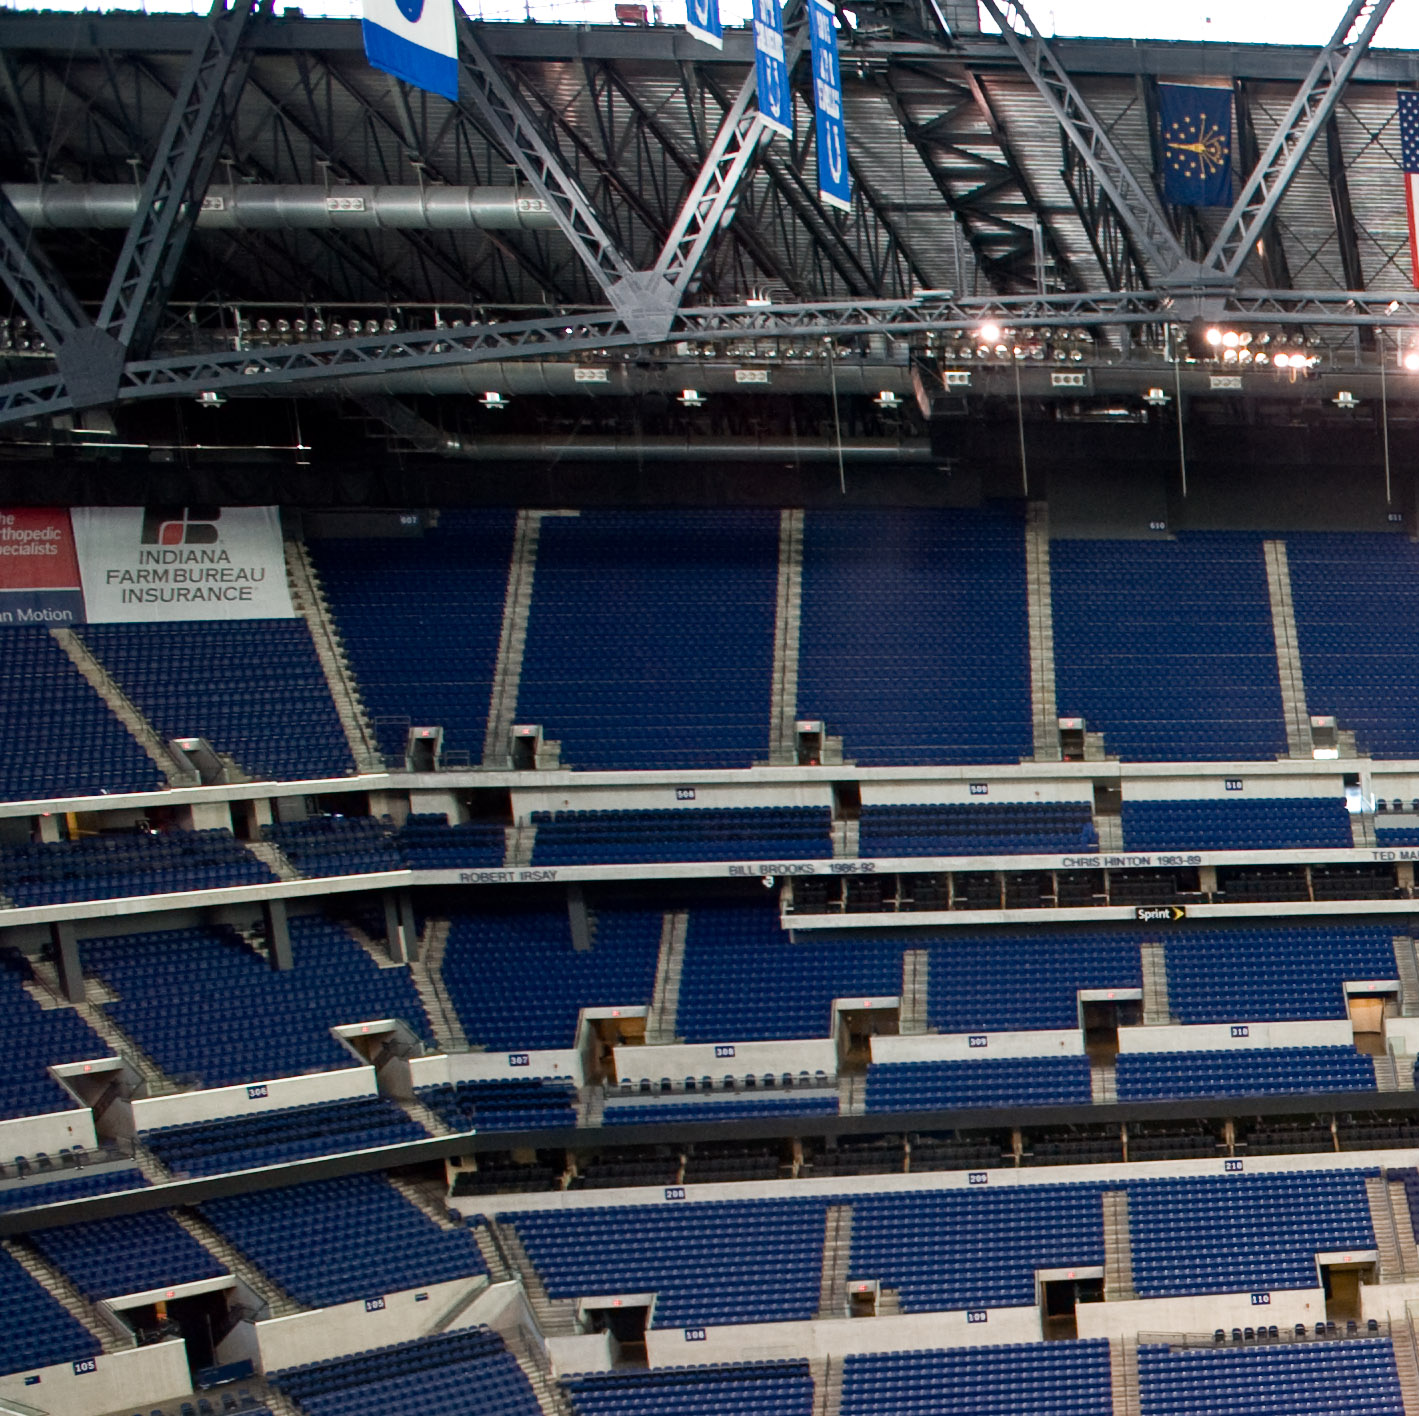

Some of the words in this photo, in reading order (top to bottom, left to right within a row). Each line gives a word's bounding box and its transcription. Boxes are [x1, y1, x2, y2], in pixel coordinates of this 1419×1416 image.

[0, 511, 14, 525] he
[400, 516, 417, 524] 607
[0, 526, 61, 543] thopedic
[139, 549, 230, 565] INDIANA
[106, 569, 172, 585] FARM
[174, 567, 265, 583] BUREAU
[122, 586, 252, 604] INSURANCE
[17, 607, 73, 622] Motion
[1226, 781, 1243, 790] 510
[1062, 856, 1100, 867] CHRIS
[1104, 855, 1151, 867] HINTON
[1372, 850, 1396, 861] TED
[729, 865, 756, 876] BILL
[760, 864, 815, 875] BROOKS
[460, 871, 514, 883] ROBERT
[520, 869, 558, 882] IRSAY
[1137, 906, 1171, 922] Sprint
[1232, 1027, 1249, 1036] 310
[970, 1037, 987, 1046] 309
[716, 1047, 735, 1056] 308
[510, 1056, 528, 1065] 307
[248, 1086, 268, 1098] 306
[1225, 1161, 1243, 1170] 210
[970, 1174, 987, 1183] 209
[666, 1190, 685, 1198] 208
[366, 1299, 385, 1310] 105
[1251, 1294, 1270, 1304] 110
[968, 1312, 986, 1322] 109
[685, 1330, 704, 1340] 108
[75, 1361, 96, 1372] 105
